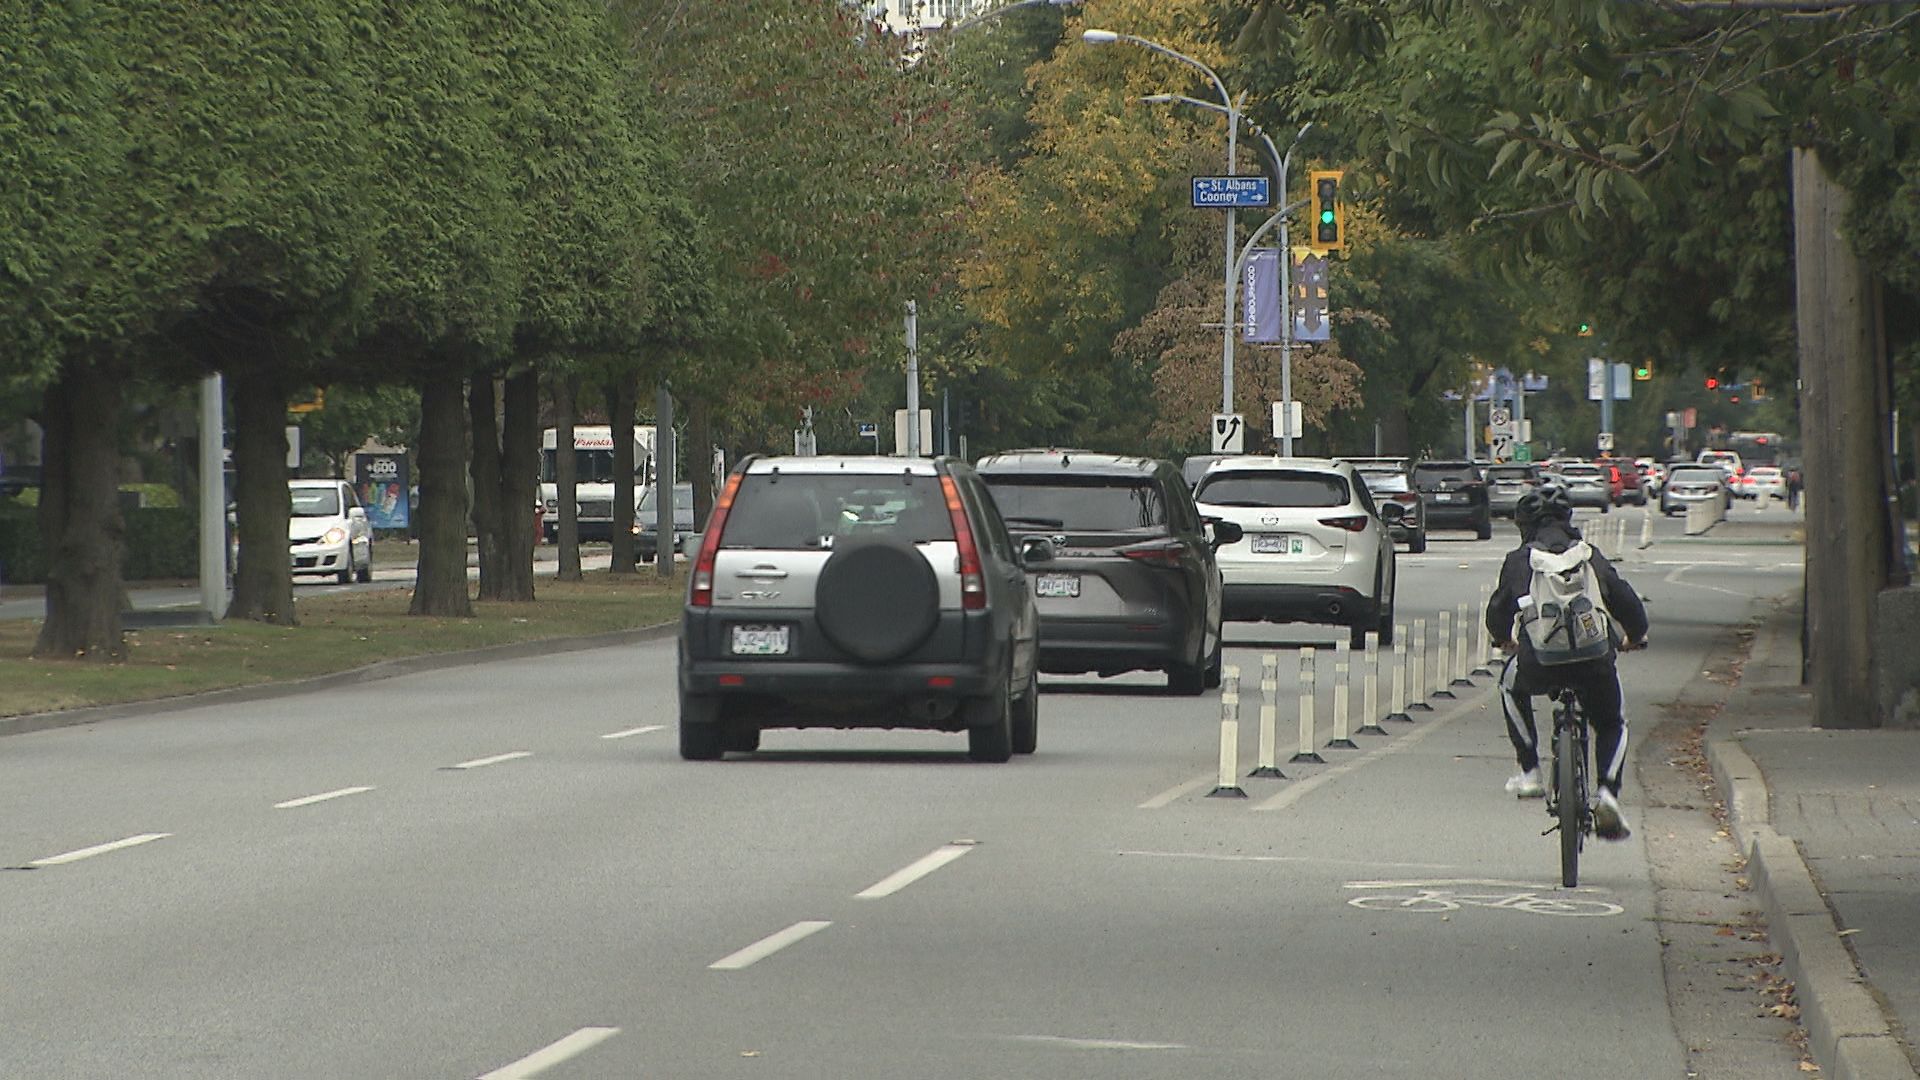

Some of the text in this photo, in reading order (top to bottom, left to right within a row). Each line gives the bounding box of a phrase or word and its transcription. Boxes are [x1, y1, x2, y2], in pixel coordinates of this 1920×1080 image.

[1211, 180, 1257, 192] St. Albans
[1200, 191, 1238, 204] Cooney
